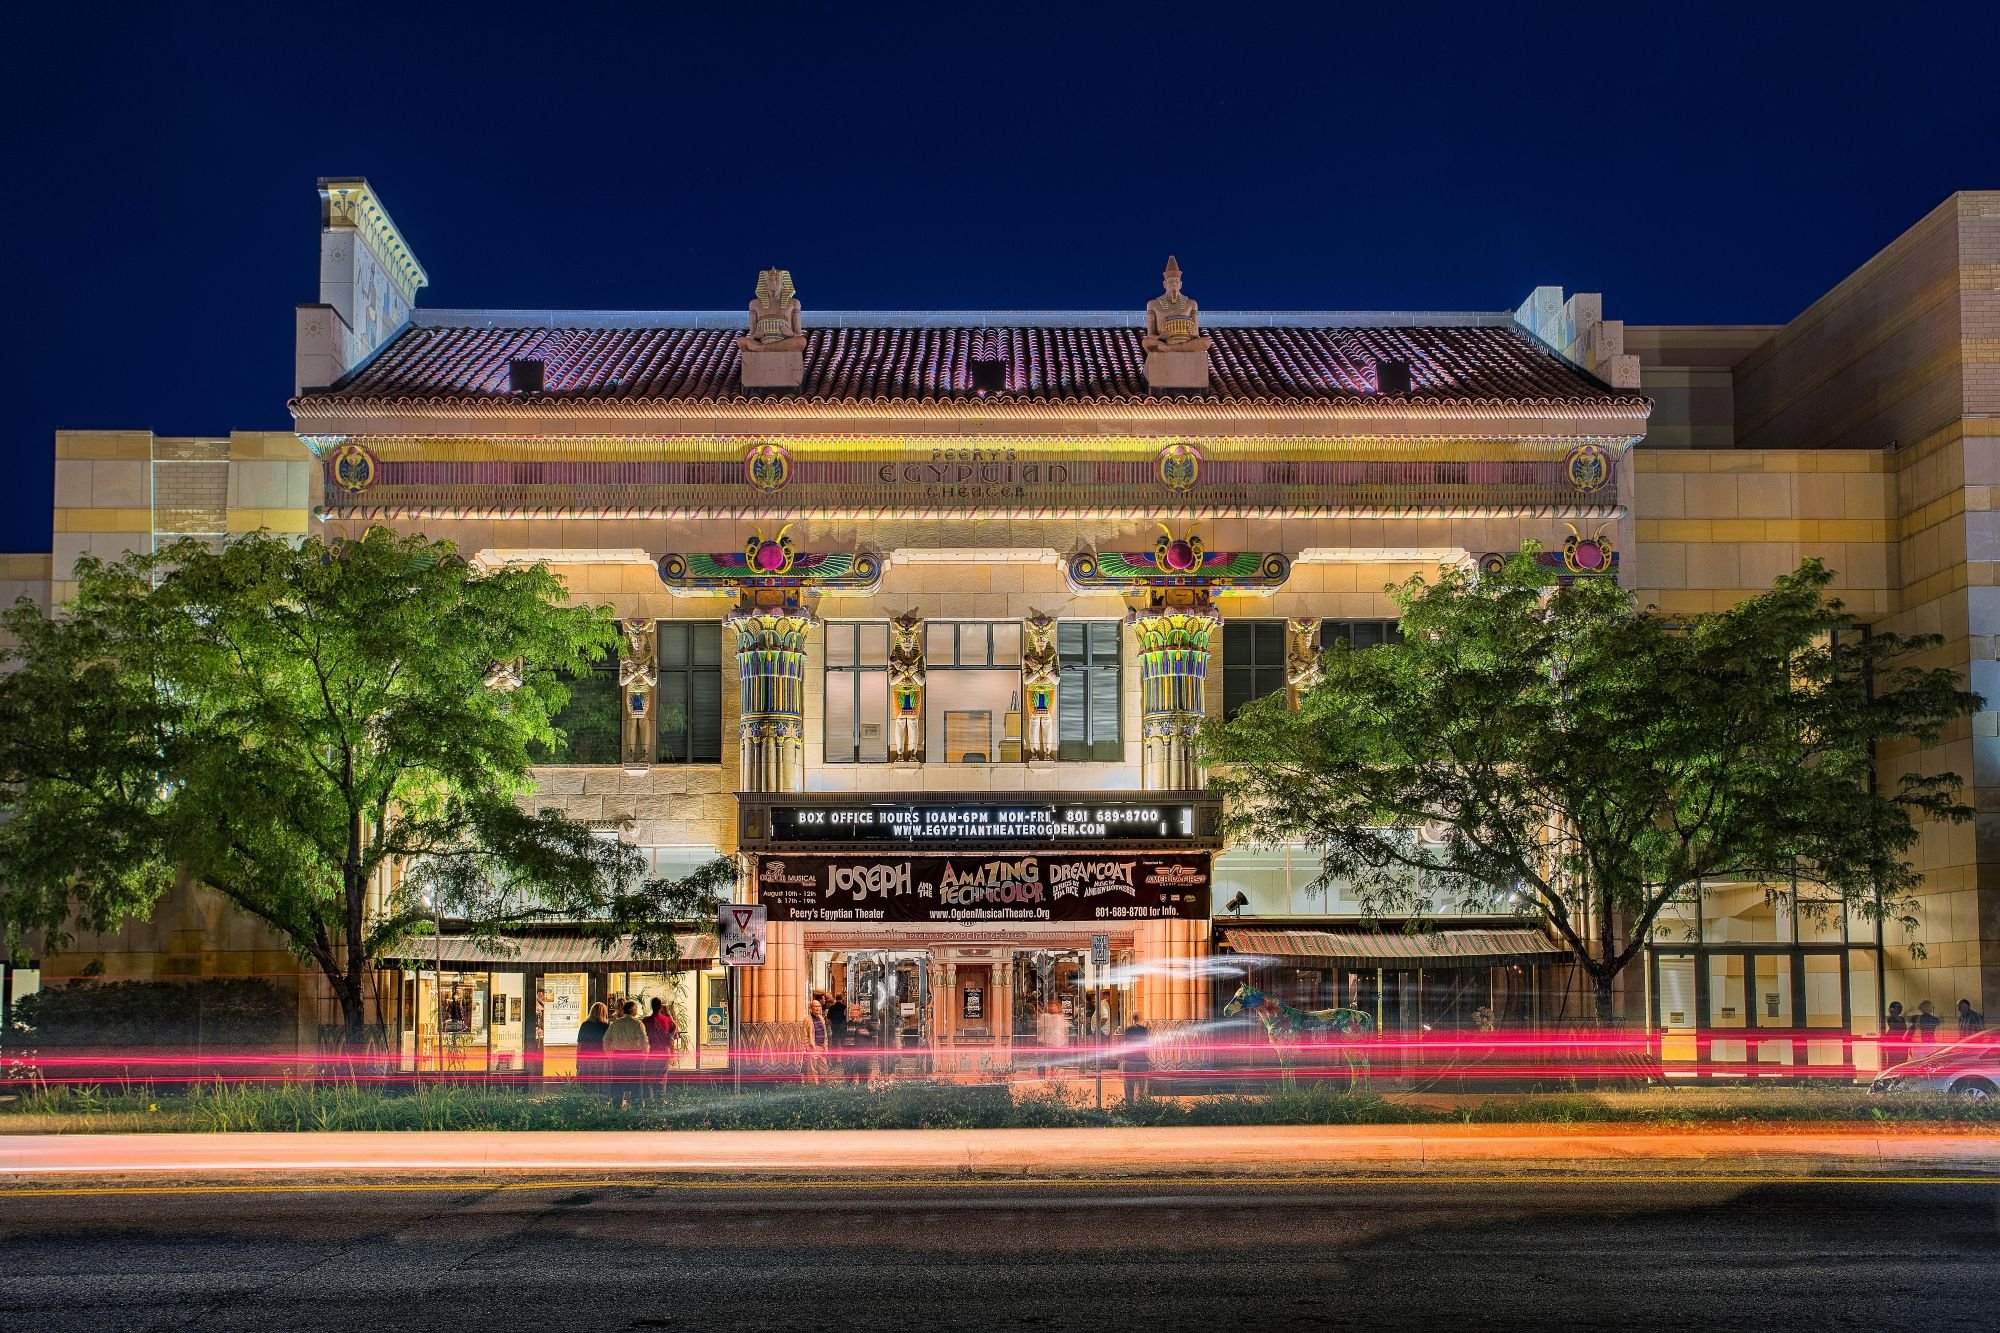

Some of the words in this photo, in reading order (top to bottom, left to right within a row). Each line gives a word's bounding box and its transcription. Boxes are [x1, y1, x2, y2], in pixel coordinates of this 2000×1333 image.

[932, 448, 1017, 461] PEERY'S
[879, 463, 1068, 484] EGYPTIAN
[927, 486, 1026, 498] THEATER
[800, 812, 825, 824] BOX
[831, 812, 873, 824] OFFICE
[879, 812, 920, 824] HOURS
[925, 811, 988, 823] 10AM-6PM
[999, 811, 1051, 823] MON-FRI
[1066, 811, 1088, 822] 801
[1096, 811, 1158, 822] 689-8700
[893, 823, 1105, 836] WWW.EGYPTIANTHEATEROGDEN.COM
[787, 874, 816, 882] MUSICAL
[940, 857, 1039, 888] AMAZING
[1050, 861, 1136, 886] DREAMCOAT
[826, 862, 912, 900] JOSEPH
[918, 881, 933, 890] AND
[919, 889, 933, 898] THE
[790, 908, 818, 920] Peery's
[820, 908, 853, 920] Egyptian
[855, 908, 884, 918] Theater
[930, 908, 1050, 920] www.OgdenMusicalTheatre.Org
[1095, 906, 1147, 917] 801-689-8700
[1150, 906, 1160, 916] for
[1162, 905, 1179, 916] Info.
